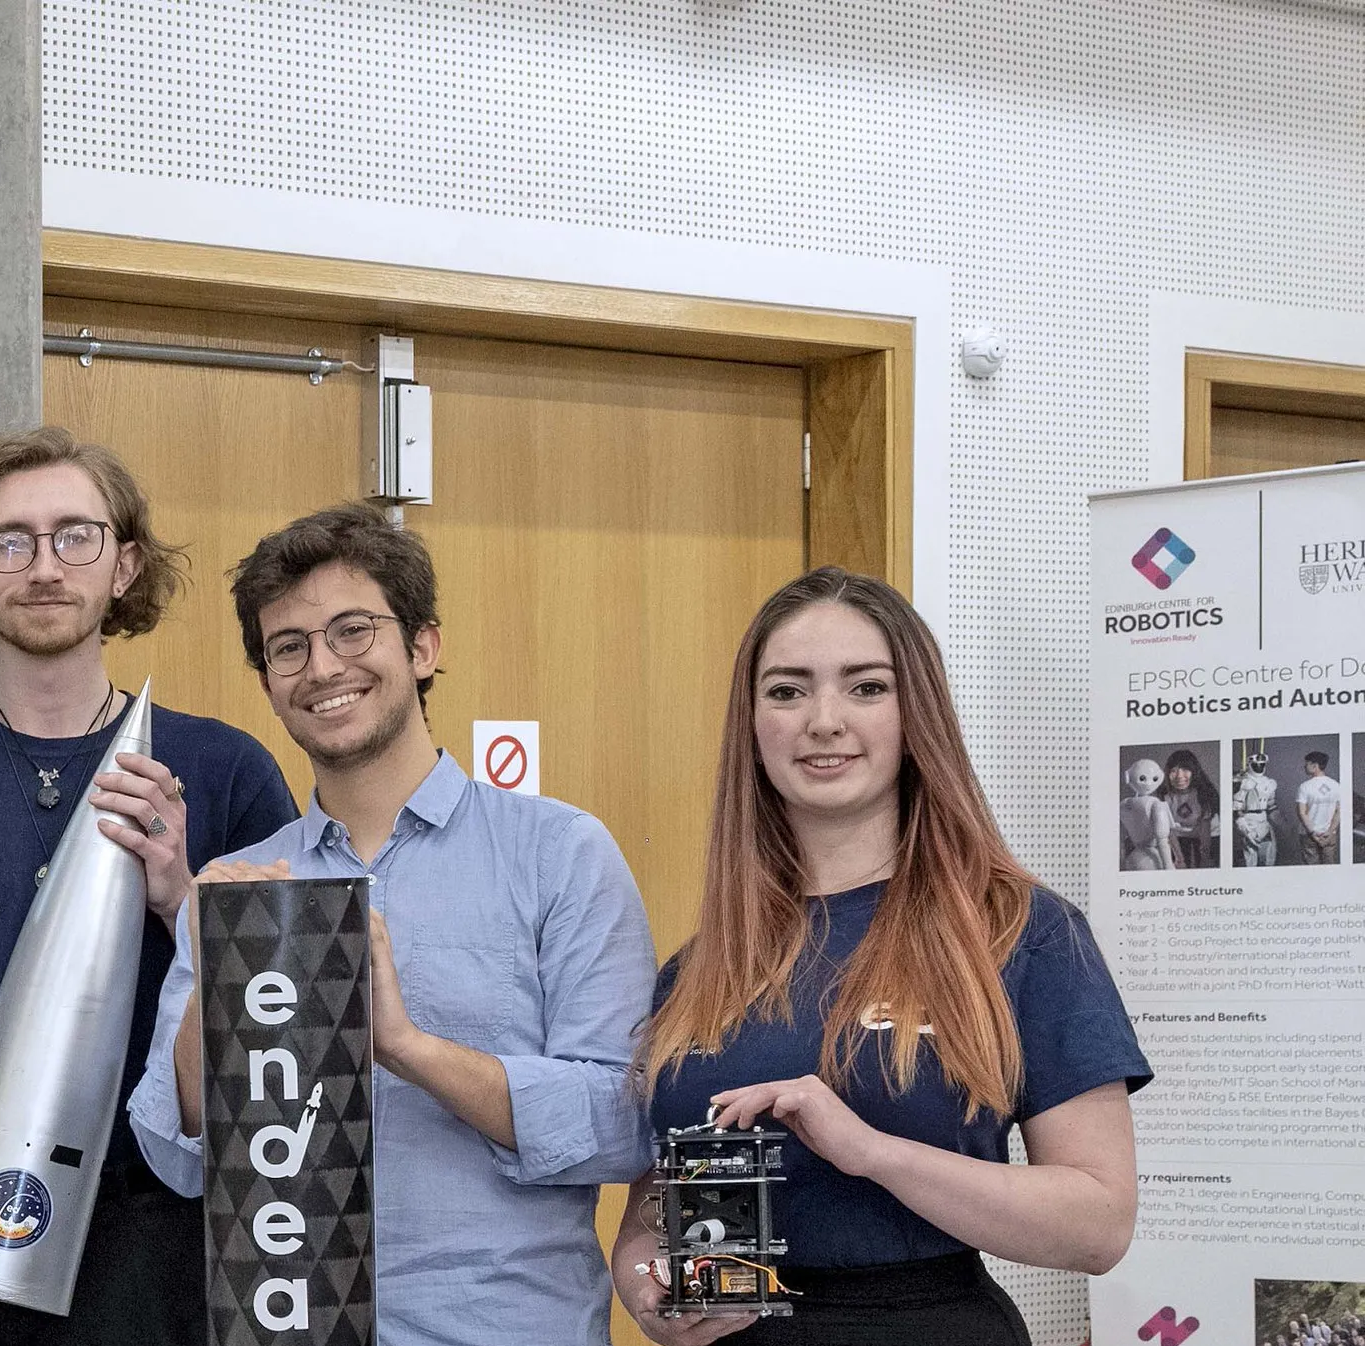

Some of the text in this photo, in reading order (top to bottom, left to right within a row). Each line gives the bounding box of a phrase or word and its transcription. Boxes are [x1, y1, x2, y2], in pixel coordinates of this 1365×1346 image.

[1105, 596, 1215, 614] EDINBURGH CENTRE FOR
[1105, 607, 1223, 634] ROBOTICS
[1130, 634, 1197, 645] Innovation Ready
[1128, 667, 1206, 692] EPSRC
[1212, 664, 1293, 687] Centre
[1299, 659, 1333, 680] for
[1126, 695, 1231, 718] Robotics
[1237, 689, 1282, 710] and
[1119, 886, 1243, 900] Programme Structure
[1125, 908, 1160, 920] 4-year
[1162, 907, 1185, 917] PhD
[1187, 907, 1209, 917] with
[1212, 906, 1264, 917] Technical
[1267, 905, 1316, 917] Learning
[1126, 923, 1149, 933] Year
[1183, 921, 1221, 932] credits
[1222, 923, 1237, 931] on
[1240, 920, 1263, 931] MSc
[1266, 921, 1311, 930] courses
[1314, 920, 1328, 929] on
[1127, 938, 1149, 947] Year
[1169, 937, 1202, 948] Group
[1205, 936, 1243, 948] Project
[1247, 937, 1258, 945] to
[1261, 936, 1321, 947] encourage
[1127, 953, 1149, 962] Year
[1289, 950, 1350, 961] placement
[1127, 967, 1149, 977] Year
[1227, 966, 1248, 976] and
[1250, 965, 1295, 978] industry
[1299, 965, 1355, 975] readiness
[1127, 981, 1176, 992] Graduate
[1179, 981, 1200, 990] with
[1210, 981, 1235, 992] joint
[1238, 980, 1262, 990] PhD
[1265, 980, 1292, 990] from
[1143, 1011, 1267, 1022] Features and Benefits
[1150, 1033, 1188, 1043] funded
[1191, 1033, 1262, 1045] studentships
[1265, 1033, 1316, 1044] including
[1318, 1032, 1362, 1043] stipend
[1204, 1047, 1363, 1059] for international placements
[1185, 1063, 1342, 1075] funds to support early stage
[1281, 1077, 1320, 1088] School
[1324, 1077, 1335, 1088] of
[1132, 1093, 1168, 1102] upport
[1171, 1092, 1186, 1101] for
[1264, 1092, 1323, 1103] Enterprise
[1133, 1107, 1164, 1116] ccess
[1167, 1107, 1178, 1116] to
[1180, 1107, 1210, 1117] world
[1212, 1107, 1240, 1117] class
[1243, 1107, 1288, 1117] facilities
[1290, 1108, 1301, 1117] in
[1303, 1108, 1322, 1117] the
[1325, 1107, 1360, 1120] Bayes
[1187, 1121, 1233, 1132] bespoke
[1236, 1122, 1278, 1134] training
[1281, 1123, 1349, 1134] programme
[1136, 1136, 1356, 1149] pportunities to compete in international
[1153, 1173, 1232, 1184] requirements
[1198, 1188, 1237, 1200] degree
[1240, 1190, 1249, 1199] in
[1221, 1203, 1306, 1215] Computational
[1189, 1217, 1360, 1231] and/or experience in statistical
[1177, 1232, 1324, 1245] or no individual
